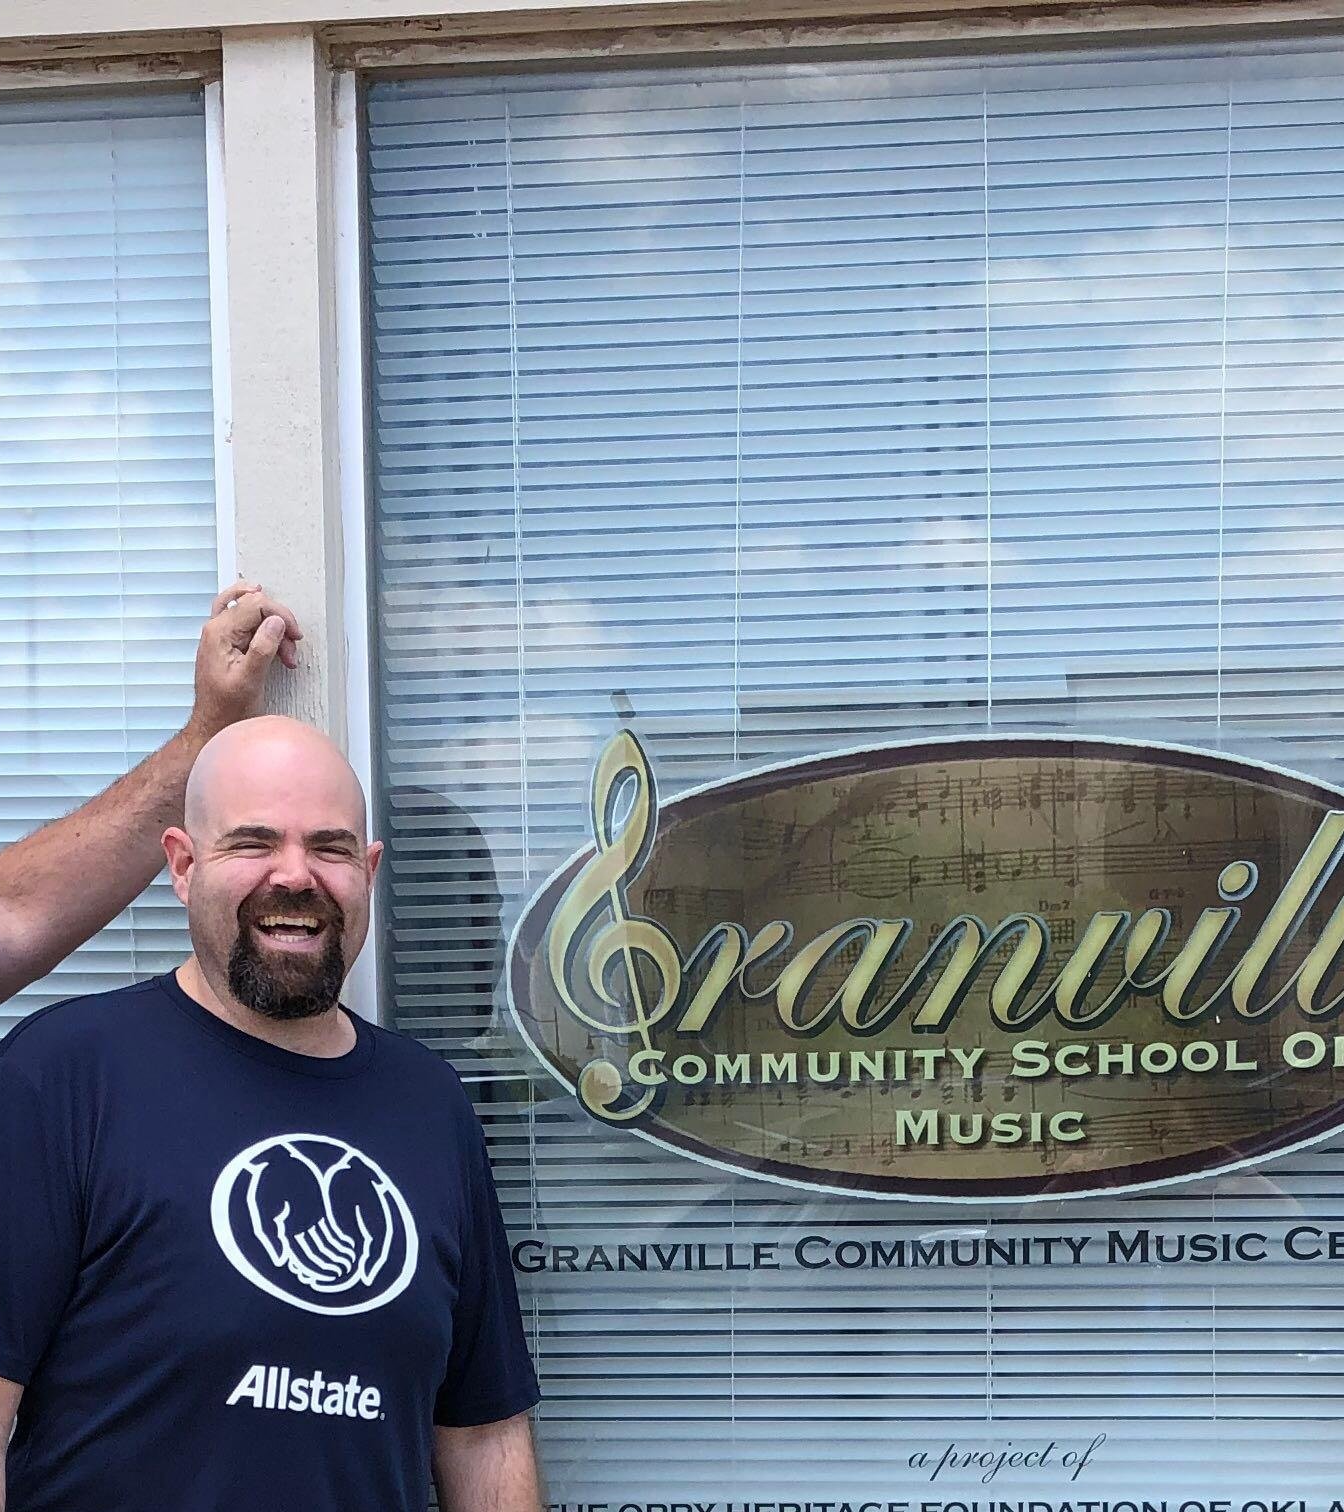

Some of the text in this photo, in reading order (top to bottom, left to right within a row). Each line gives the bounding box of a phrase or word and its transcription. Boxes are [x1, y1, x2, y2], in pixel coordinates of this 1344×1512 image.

[627, 1046, 986, 1086] COMMUNITY
[1010, 1039, 1258, 1079] SCHOOL
[894, 1108, 1089, 1147] MUSIC
[511, 1239, 780, 1273] GRANVILLE
[794, 1235, 1092, 1269] COMMUNITY
[1107, 1229, 1268, 1264] MUSIC
[908, 1433, 1107, 1484] a project of
